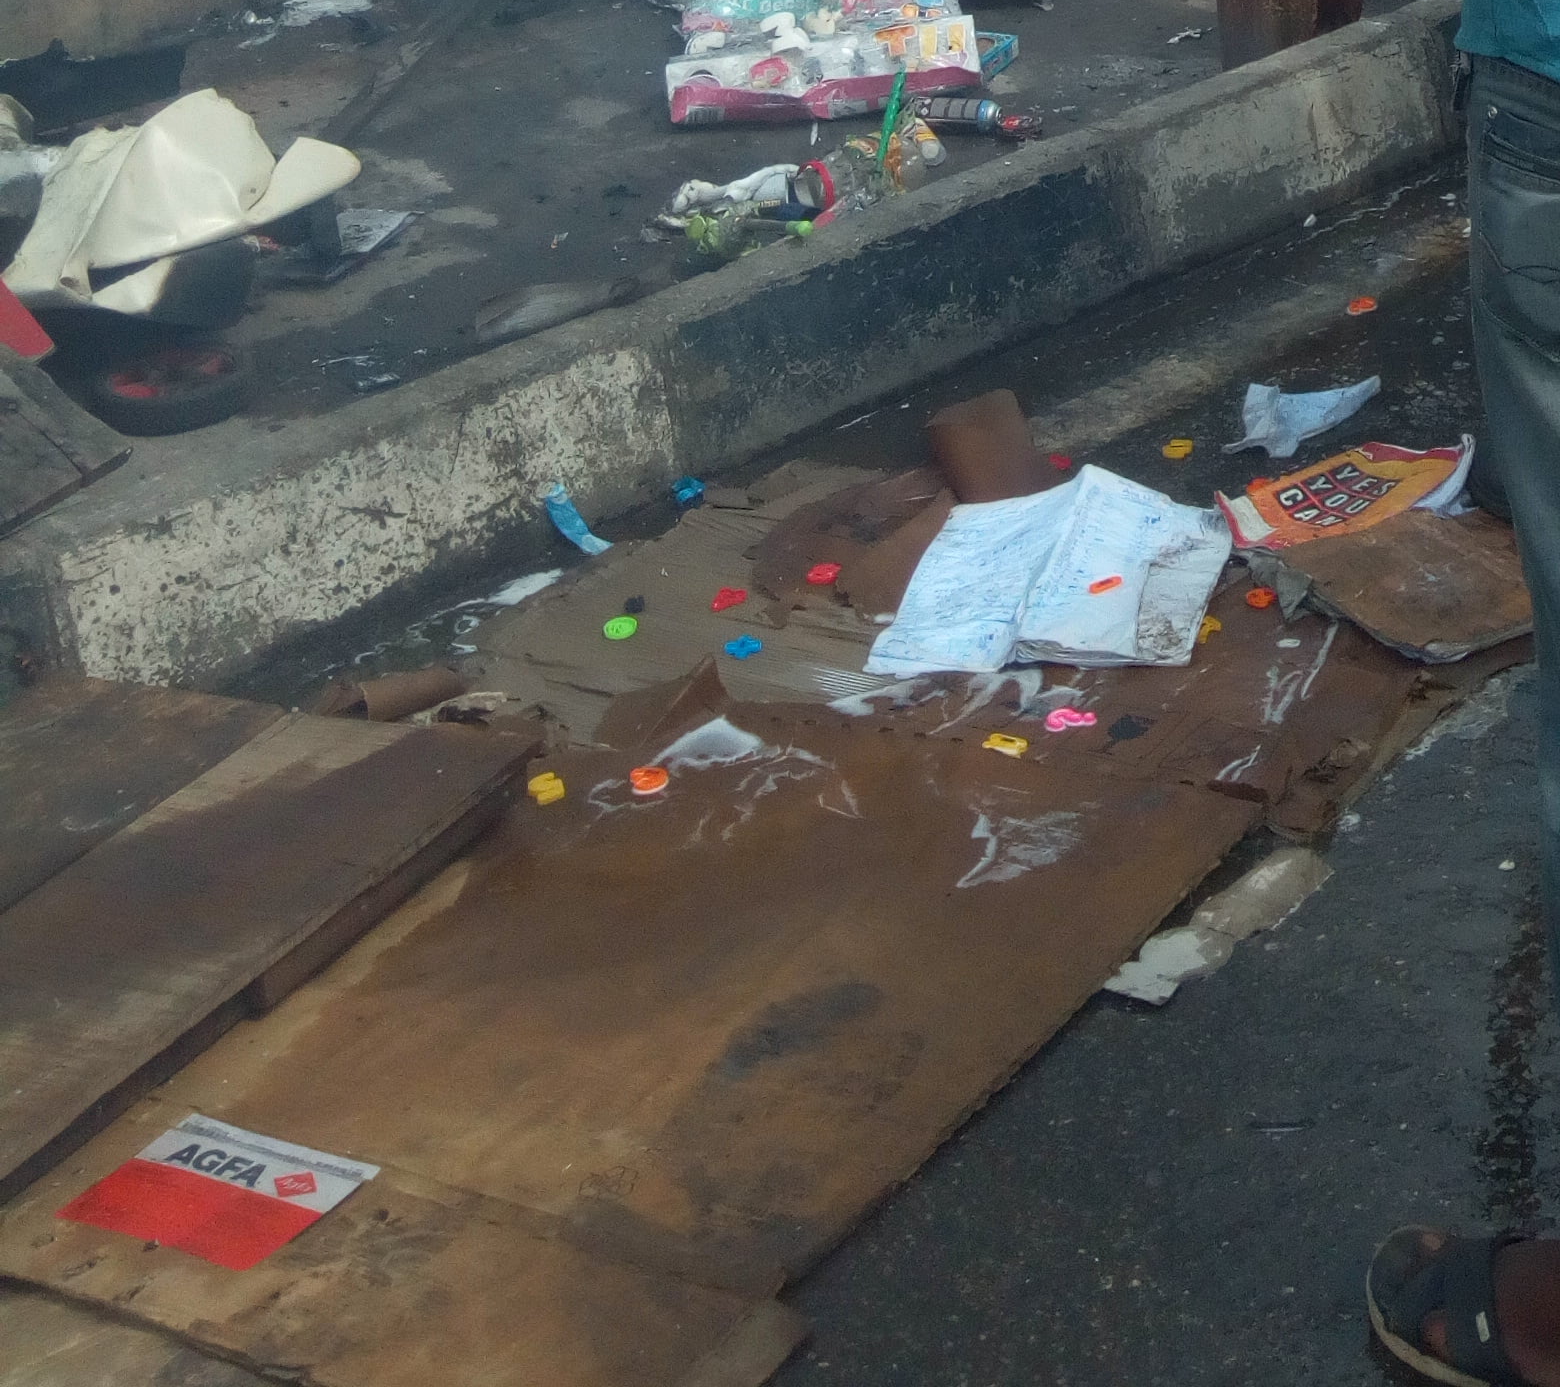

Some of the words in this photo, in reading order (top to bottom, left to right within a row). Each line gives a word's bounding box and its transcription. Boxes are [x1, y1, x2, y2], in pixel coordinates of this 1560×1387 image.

[1309, 475, 1372, 515] YOU
[1336, 466, 1396, 497] YES
[1279, 488, 1345, 527] CAN
[164, 1143, 267, 1188] AGFA
